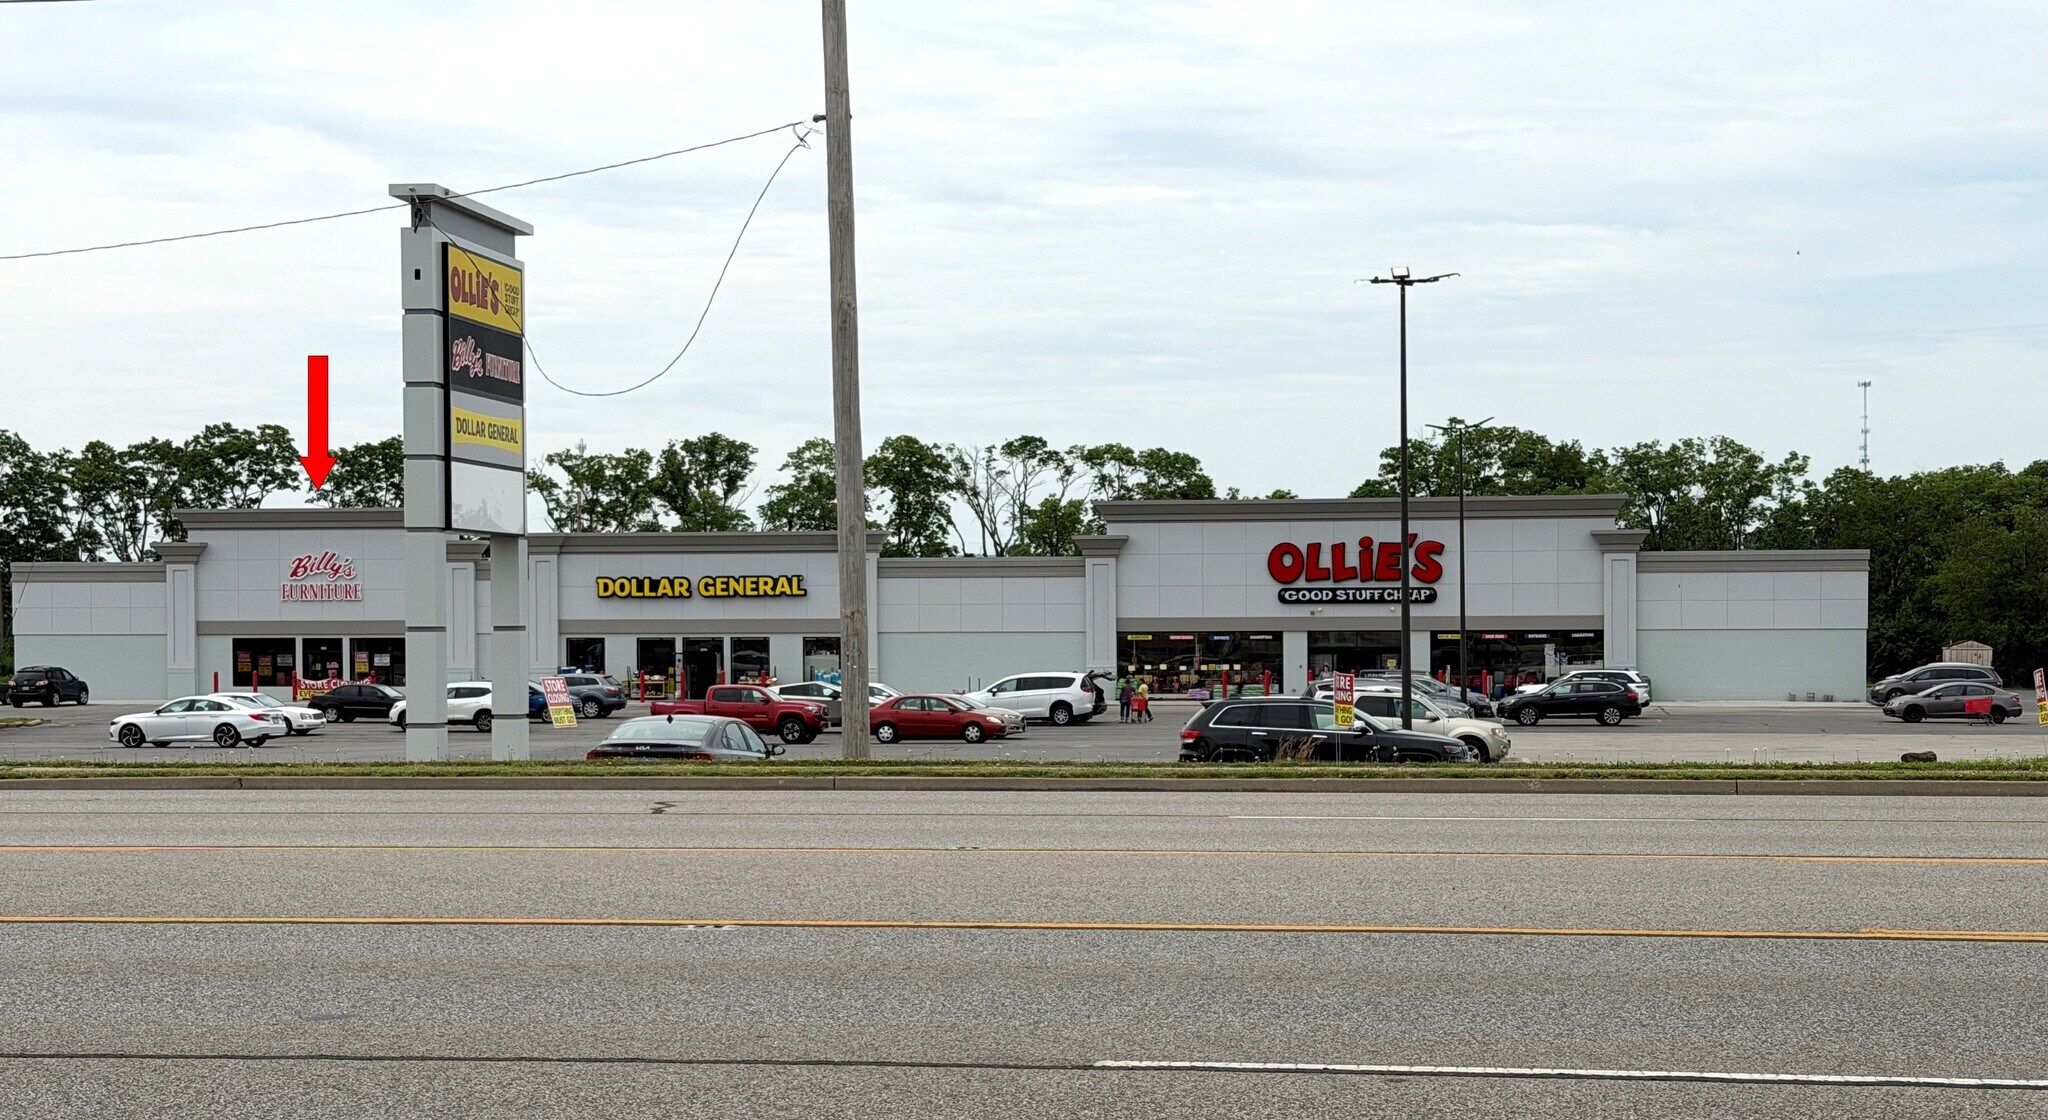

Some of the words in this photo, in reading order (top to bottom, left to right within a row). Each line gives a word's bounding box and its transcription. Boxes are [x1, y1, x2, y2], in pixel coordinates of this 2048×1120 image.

[452, 335, 483, 378] Billy's
[485, 352, 520, 384] FURNITURE
[456, 417, 486, 438] DOLLAR
[488, 422, 519, 444] GENERAL
[287, 550, 357, 582] Billy's
[281, 582, 362, 602] FURNITURE
[596, 576, 692, 598] DOLLAR
[698, 575, 807, 598] GENERAL
[1336, 589, 1383, 600] STUFF
[300, 681, 328, 690] STORE
[544, 679, 566, 692] STORE
[547, 693, 570, 704] CLOSING
